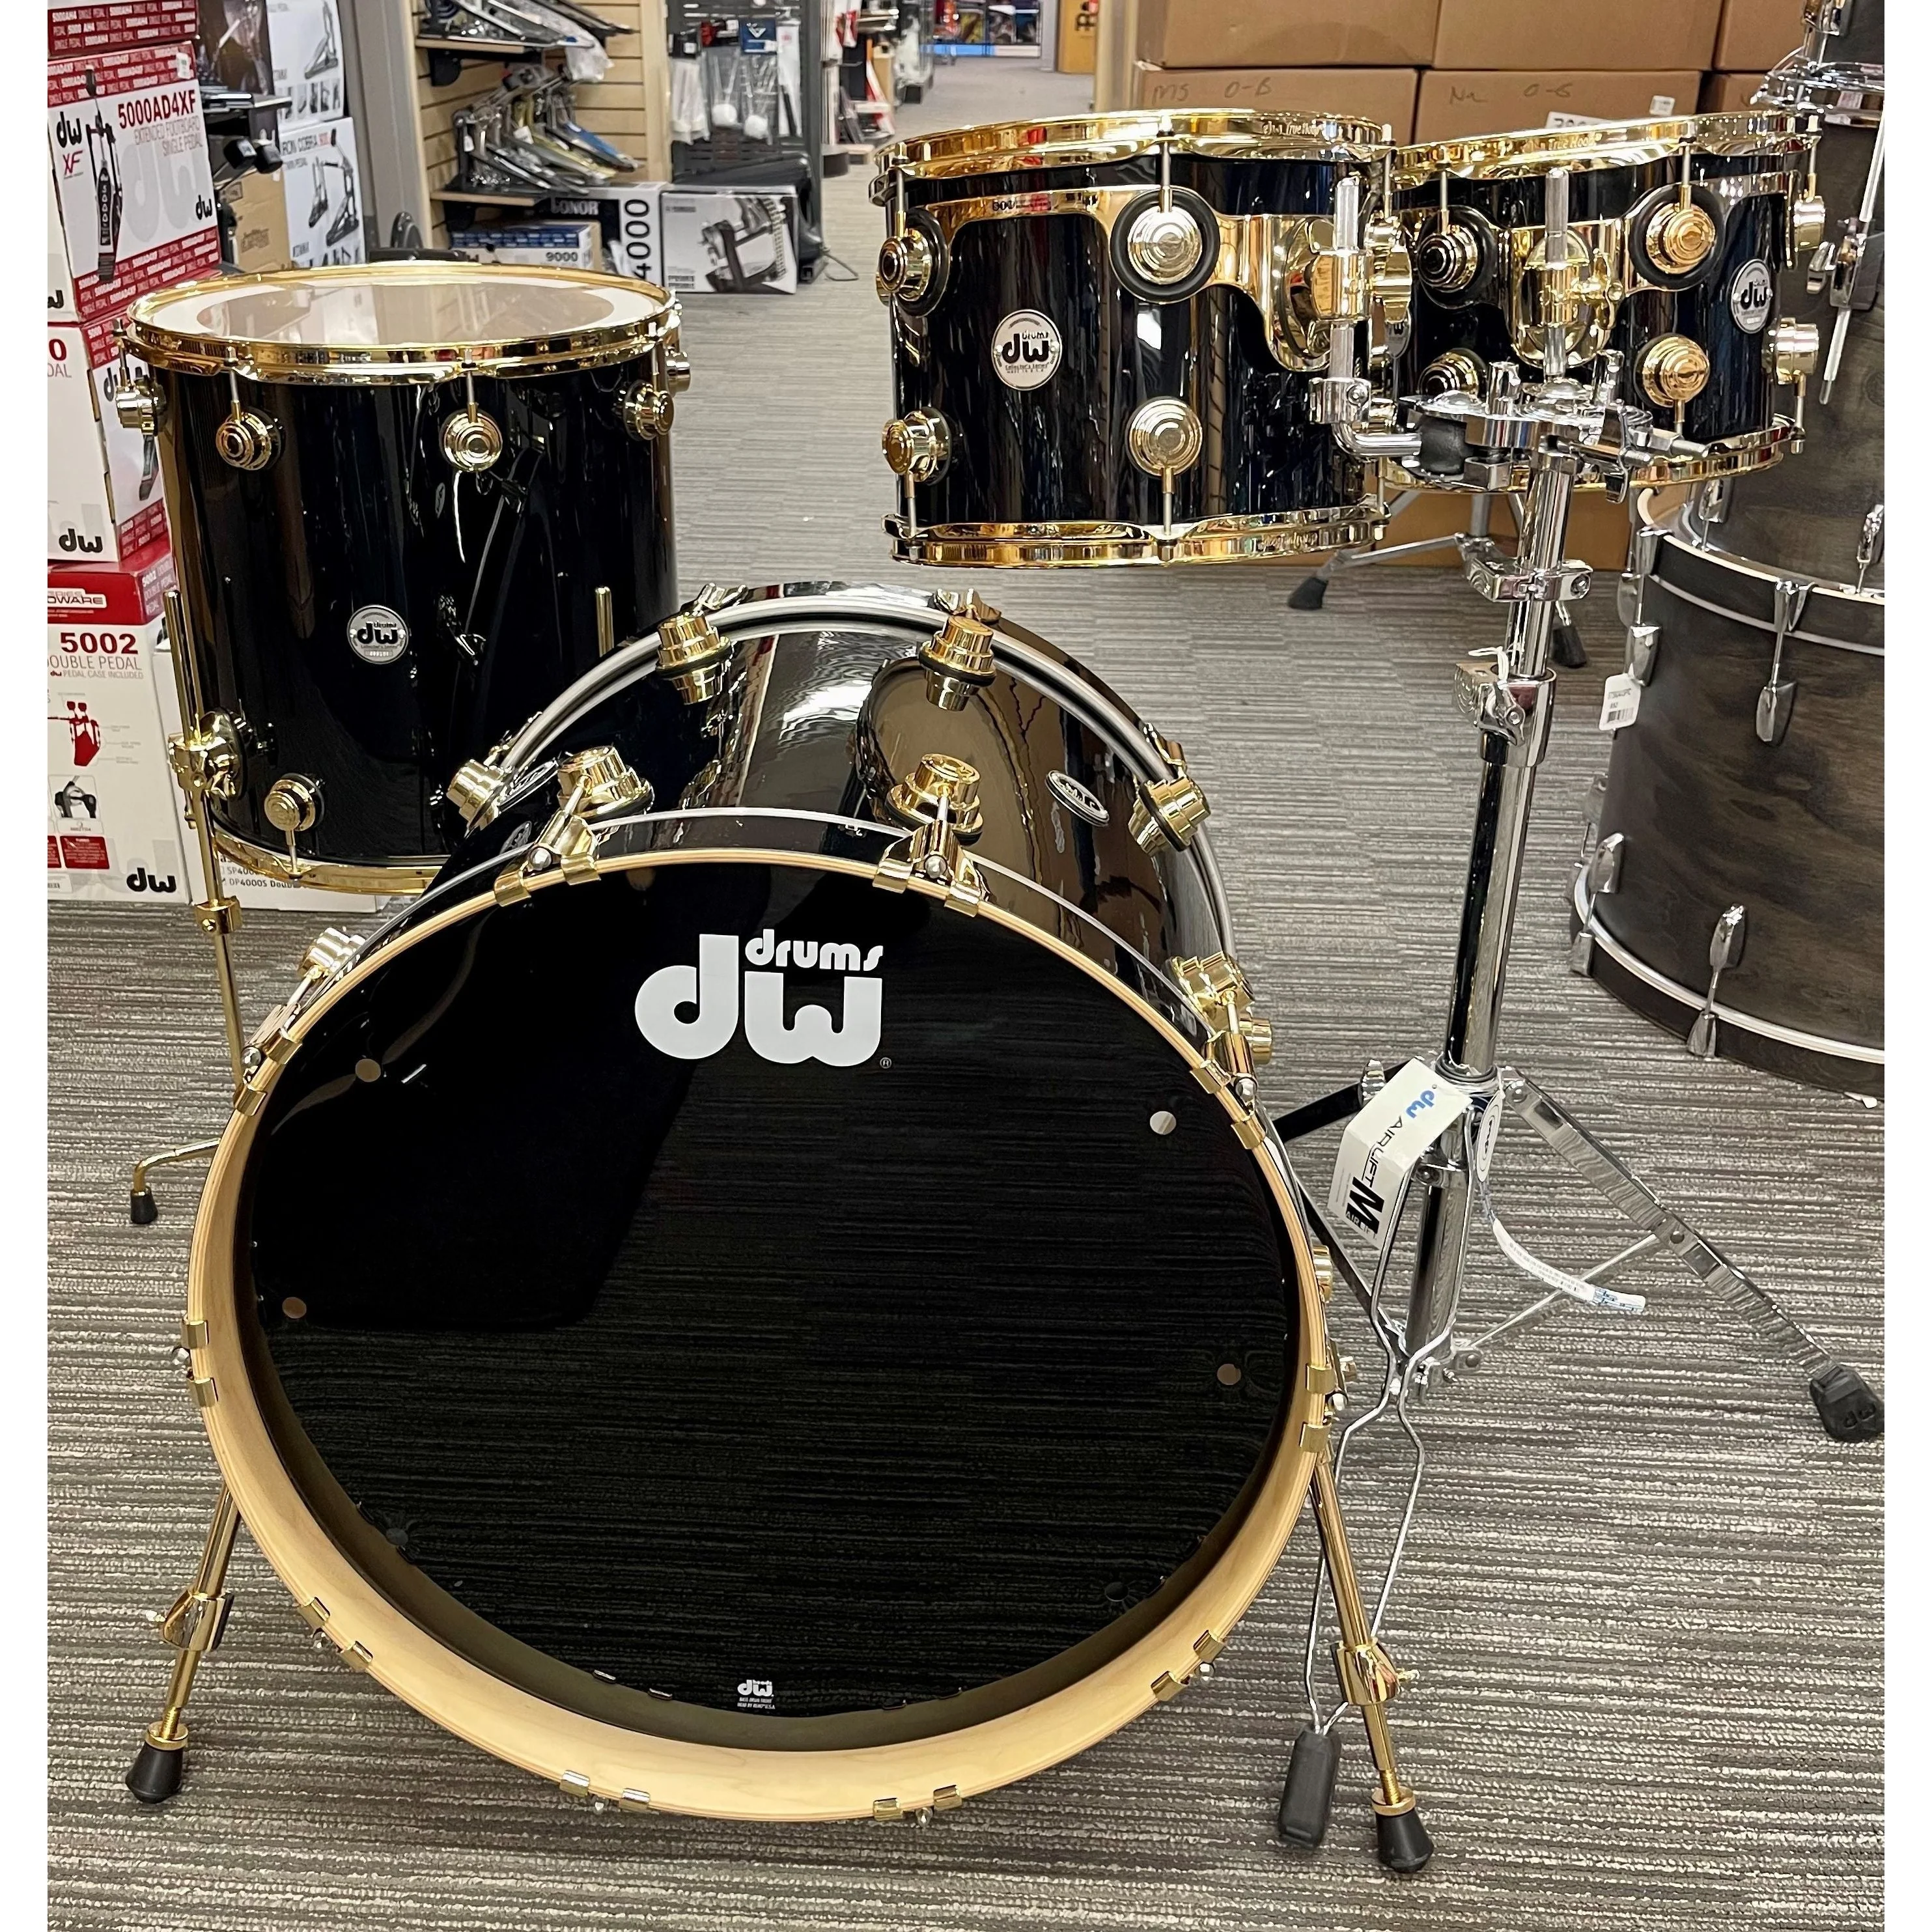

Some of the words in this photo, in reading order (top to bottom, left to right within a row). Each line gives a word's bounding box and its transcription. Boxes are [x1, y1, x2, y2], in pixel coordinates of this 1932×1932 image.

[118, 89, 196, 129] 5000AD4XF
[56, 111, 83, 148] dw
[63, 150, 83, 175] XF
[195, 194, 212, 220] dw
[546, 251, 578, 262] 9000
[1740, 281, 1767, 310] dw
[1001, 333, 1049, 364] dw
[59, 528, 104, 553] dw
[60, 632, 138, 654] 5002
[357, 623, 398, 644] dw
[48, 655, 94, 669] OUBLE
[98, 656, 142, 670] PEDAL
[87, 670, 107, 679] CASE
[108, 671, 144, 679] INCLUDED
[126, 867, 176, 893] dw
[229, 879, 268, 888] DP4000S
[745, 929, 884, 971] drums
[634, 933, 883, 1067] dw
[1406, 1089, 1435, 1119] dw
[737, 1679, 772, 1696] dw
